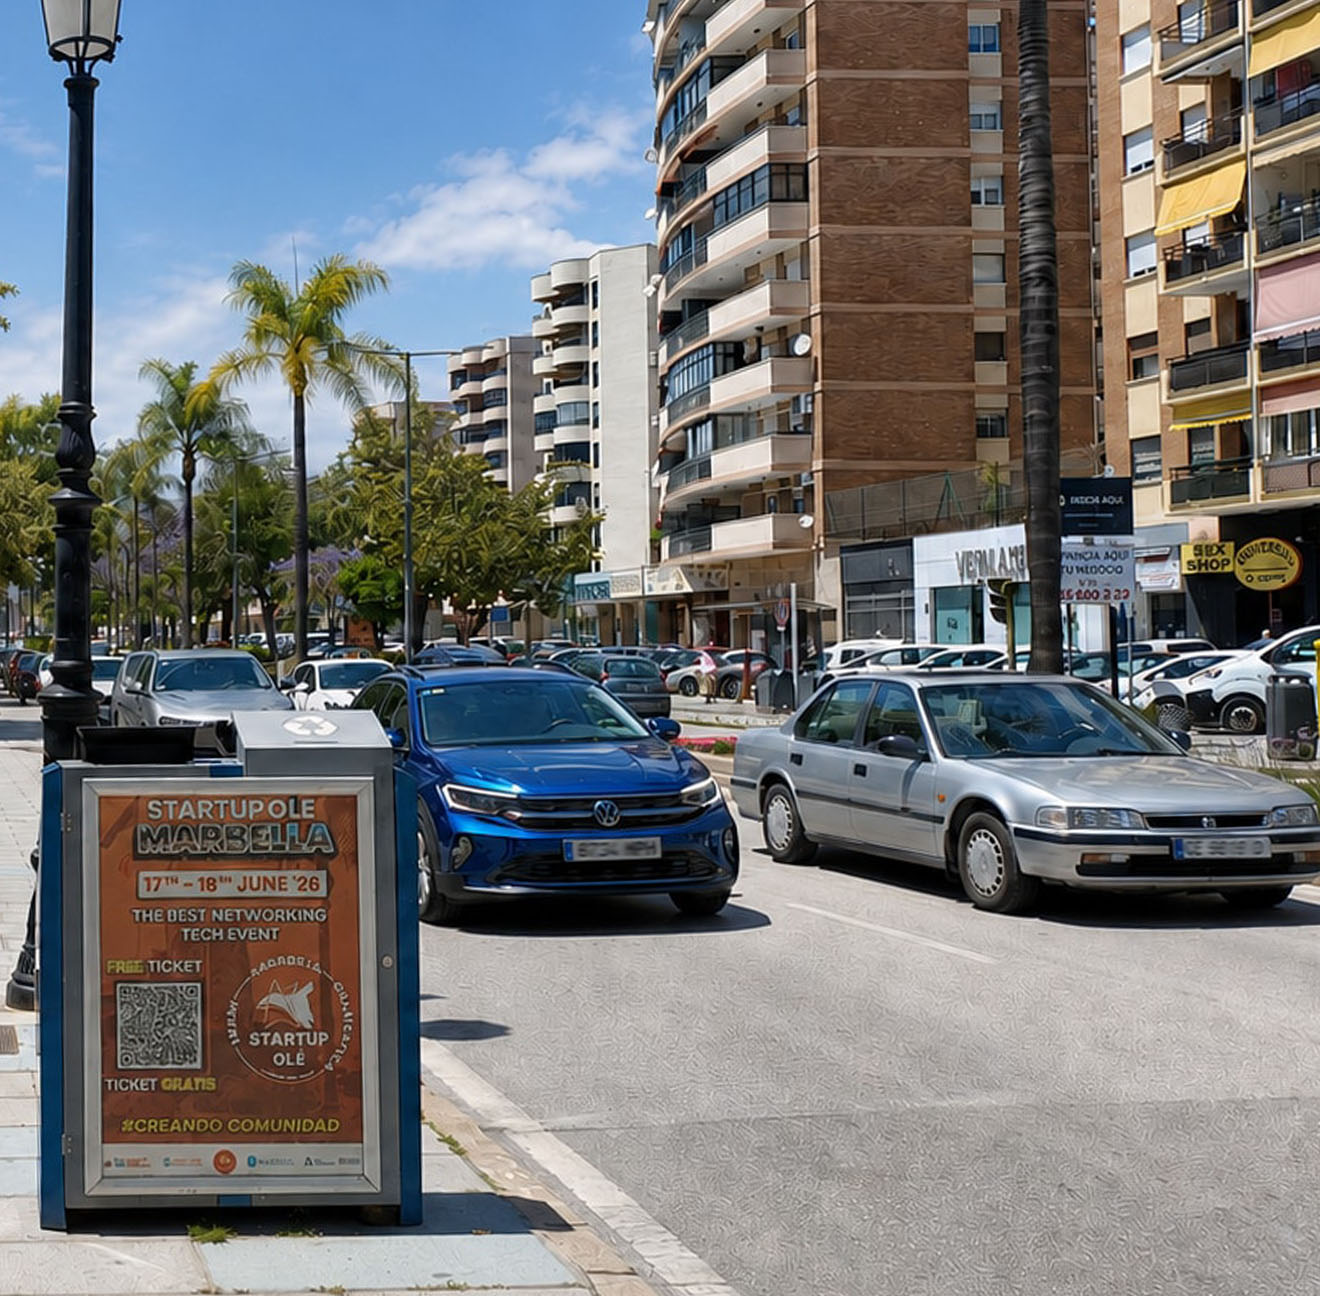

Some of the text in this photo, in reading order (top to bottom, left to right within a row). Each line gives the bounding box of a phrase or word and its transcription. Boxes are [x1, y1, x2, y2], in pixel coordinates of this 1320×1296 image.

[1193, 544, 1226, 557] SEX
[1187, 558, 1230, 571] SHOP
[136, 822, 336, 856] MARBELLA
[237, 876, 288, 893] JUNE
[133, 908, 328, 922] THE BEST NETWORKING
[181, 927, 280, 941] TECH EVENT
[107, 960, 203, 974] FREE TICKET
[249, 1031, 330, 1047] STARTUP
[105, 1077, 218, 1092] TICKET GRATIS
[121, 1117, 341, 1134] #CREANDO COMUNIDAD
